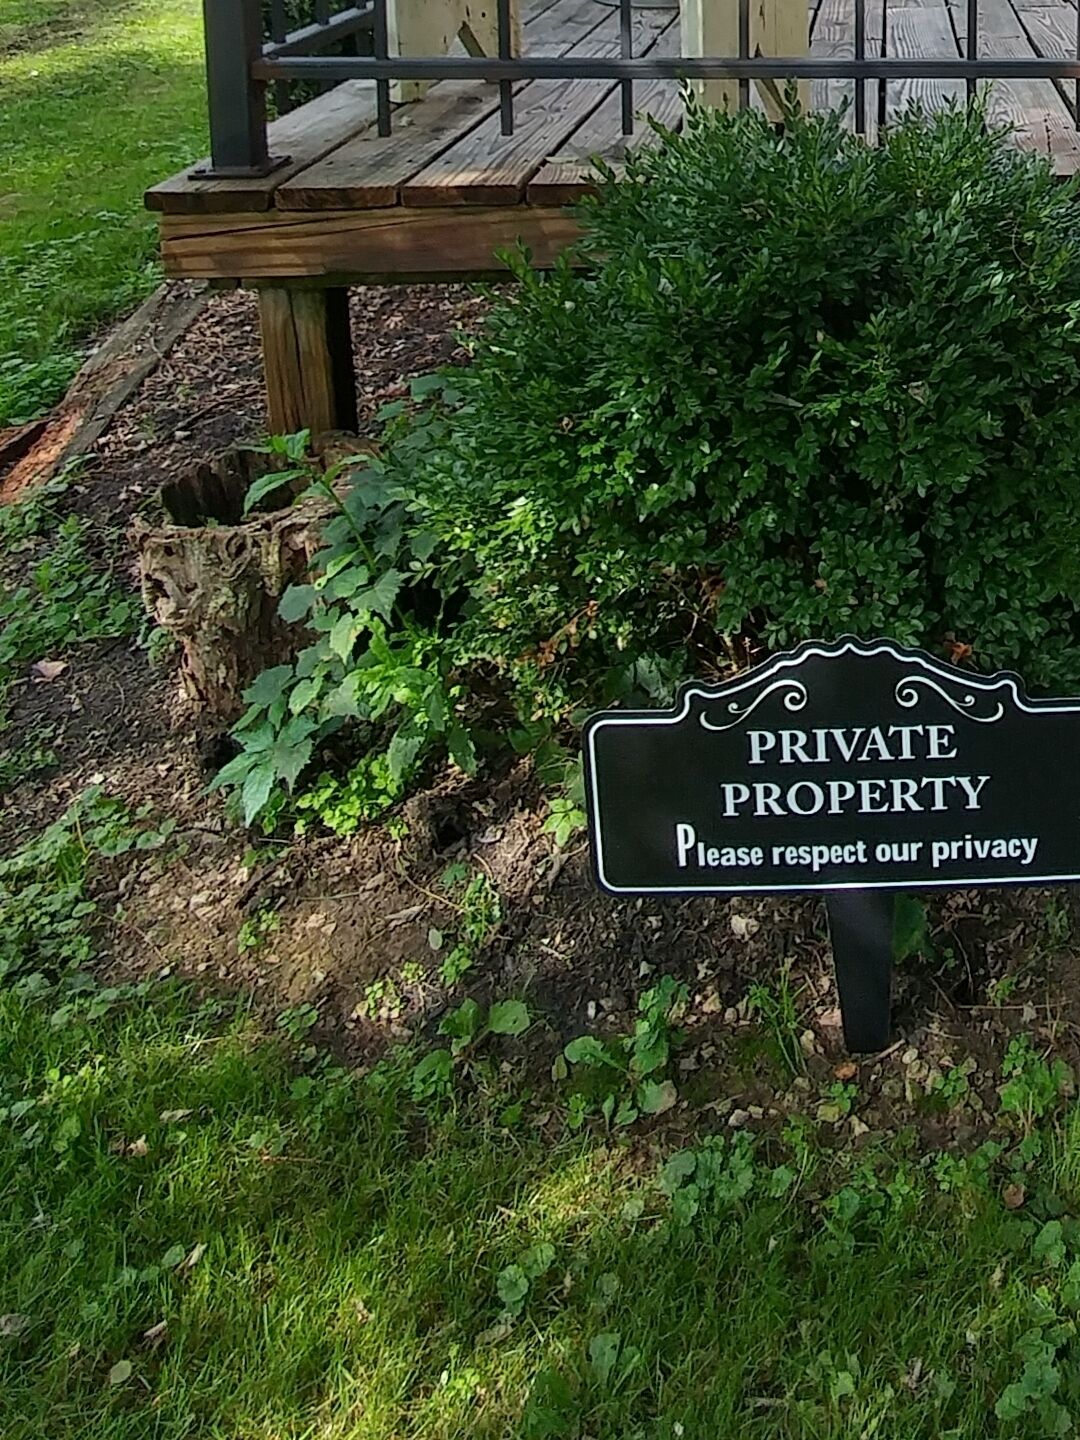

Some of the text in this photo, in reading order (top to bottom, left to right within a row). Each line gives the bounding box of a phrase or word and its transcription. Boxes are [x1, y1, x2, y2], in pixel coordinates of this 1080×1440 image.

[747, 724, 957, 764] PRIVATE
[720, 775, 991, 817] PROPERTY
[676, 823, 1039, 872] Please respect our privacy
